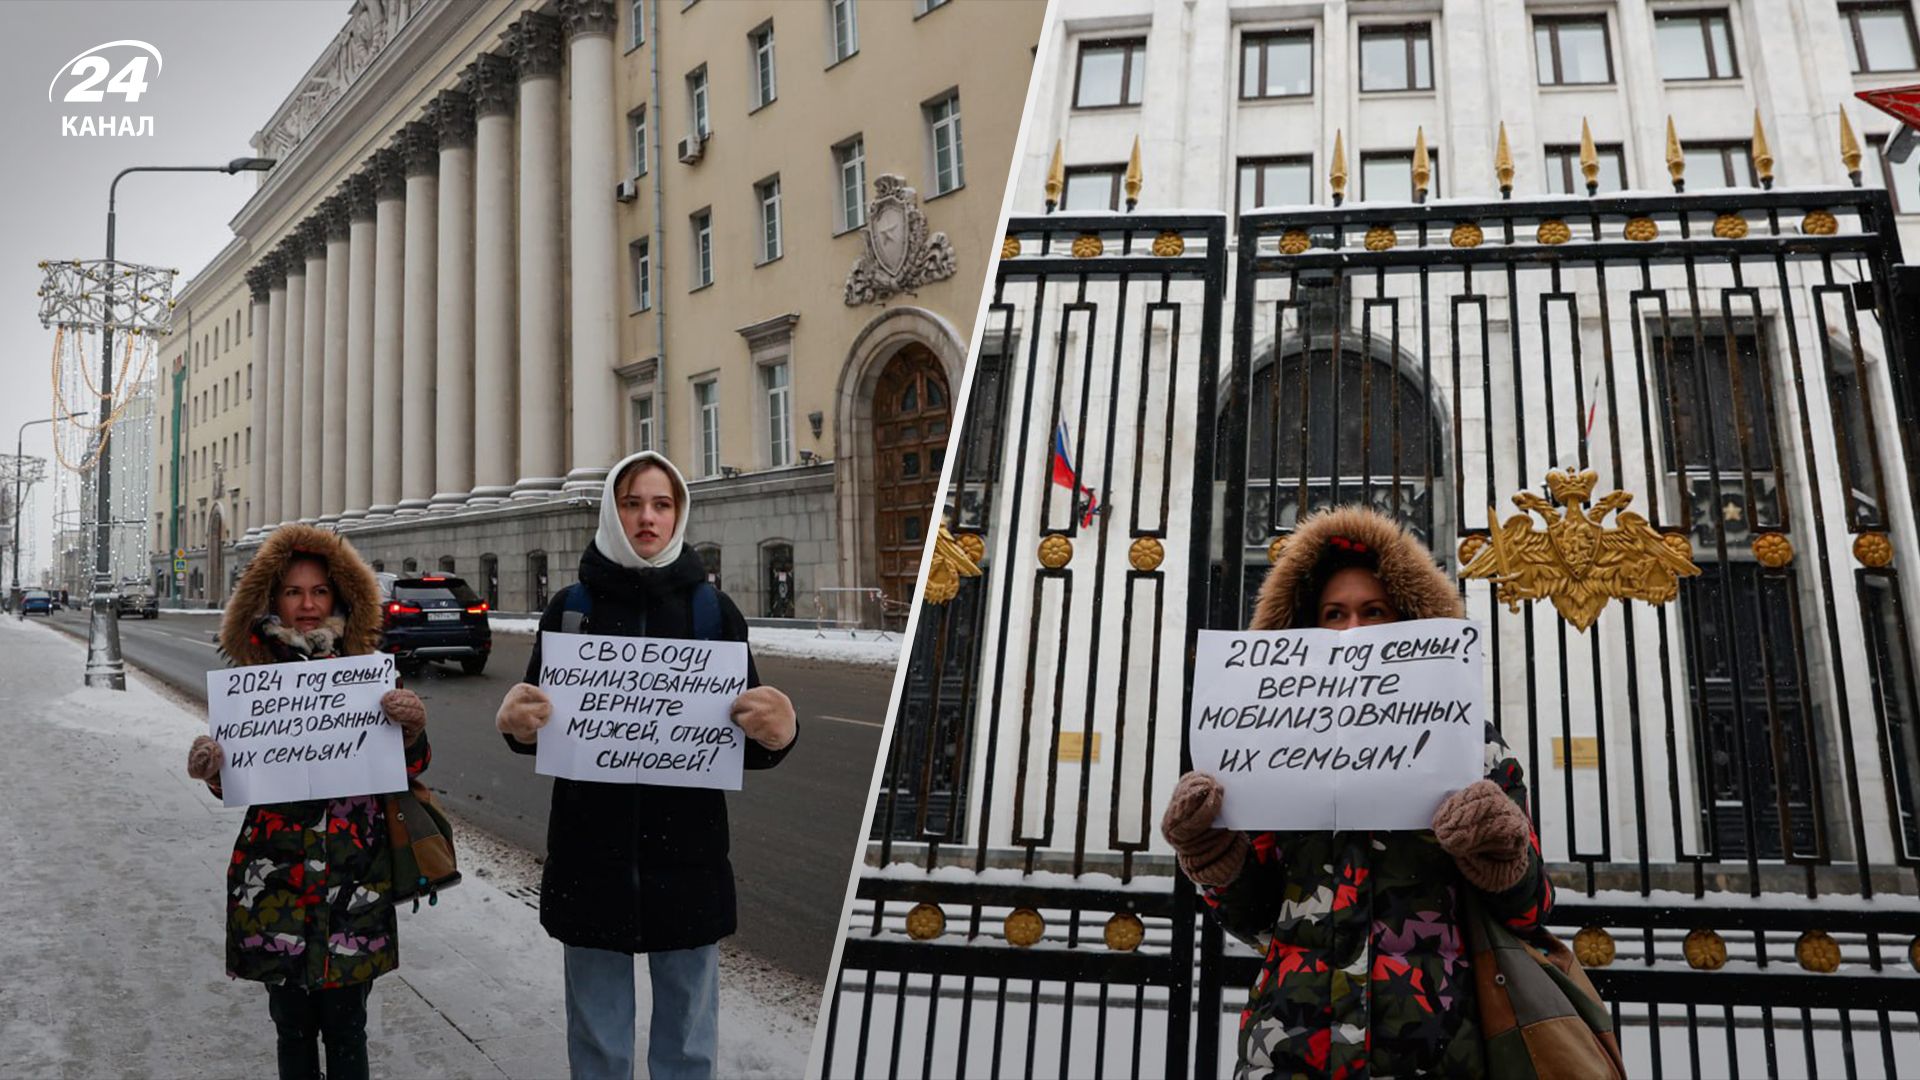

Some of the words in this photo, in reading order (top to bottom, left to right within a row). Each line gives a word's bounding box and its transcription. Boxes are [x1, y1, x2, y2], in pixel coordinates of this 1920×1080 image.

[1225, 637, 1309, 669] 2024
[227, 670, 282, 696] 2024
[541, 666, 746, 695] МОБИЛИЗОВАННЫМ
[1198, 700, 1472, 733] МОБИЛИЗОВАННЫХ
